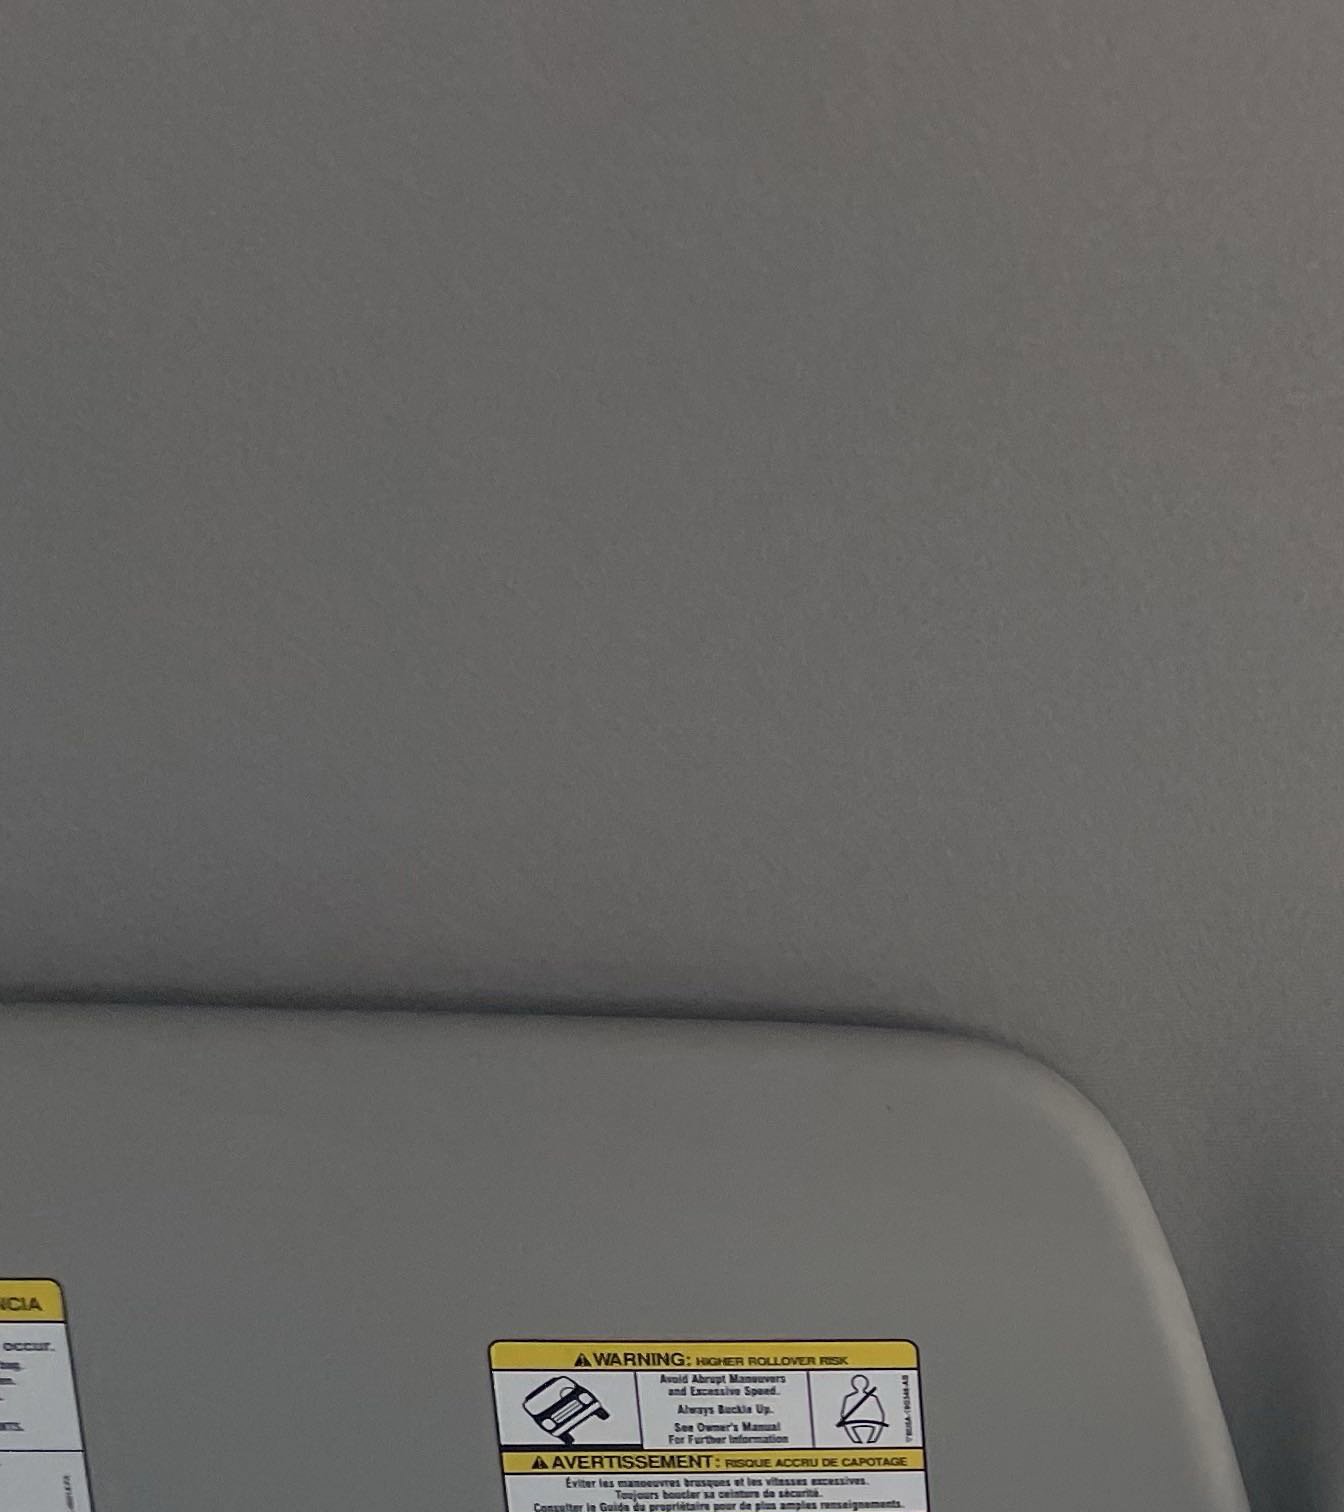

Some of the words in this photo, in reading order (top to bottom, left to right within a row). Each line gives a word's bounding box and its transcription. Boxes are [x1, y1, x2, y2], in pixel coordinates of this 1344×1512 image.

[592, 1352, 691, 1366] WARNING:
[694, 1356, 745, 1366] HIGHER
[746, 1356, 817, 1366] ROLLOVER
[818, 1356, 849, 1365] RISK
[658, 1373, 689, 1384] Avoid
[690, 1373, 726, 1385] Abrupt
[728, 1373, 786, 1383] Maneuvers
[666, 1386, 687, 1396] and
[689, 1385, 741, 1396] Excessive
[743, 1385, 781, 1397] Speed.
[676, 1404, 715, 1416] Always
[717, 1404, 752, 1414] Buckle
[754, 1403, 774, 1415] Up.
[673, 1422, 694, 1432] See
[695, 1422, 739, 1432] Owner's
[741, 1421, 781, 1431] Manual
[667, 1434, 685, 1444] For
[687, 1434, 727, 1444] Further
[727, 1433, 789, 1444] Information
[550, 1454, 721, 1470] AVERTISSEMENT:
[724, 1458, 772, 1468] RISQUE
[773, 1457, 819, 1467] ACCRU
[821, 1457, 839, 1467] DE
[840, 1456, 908, 1467] CAPOTAGE
